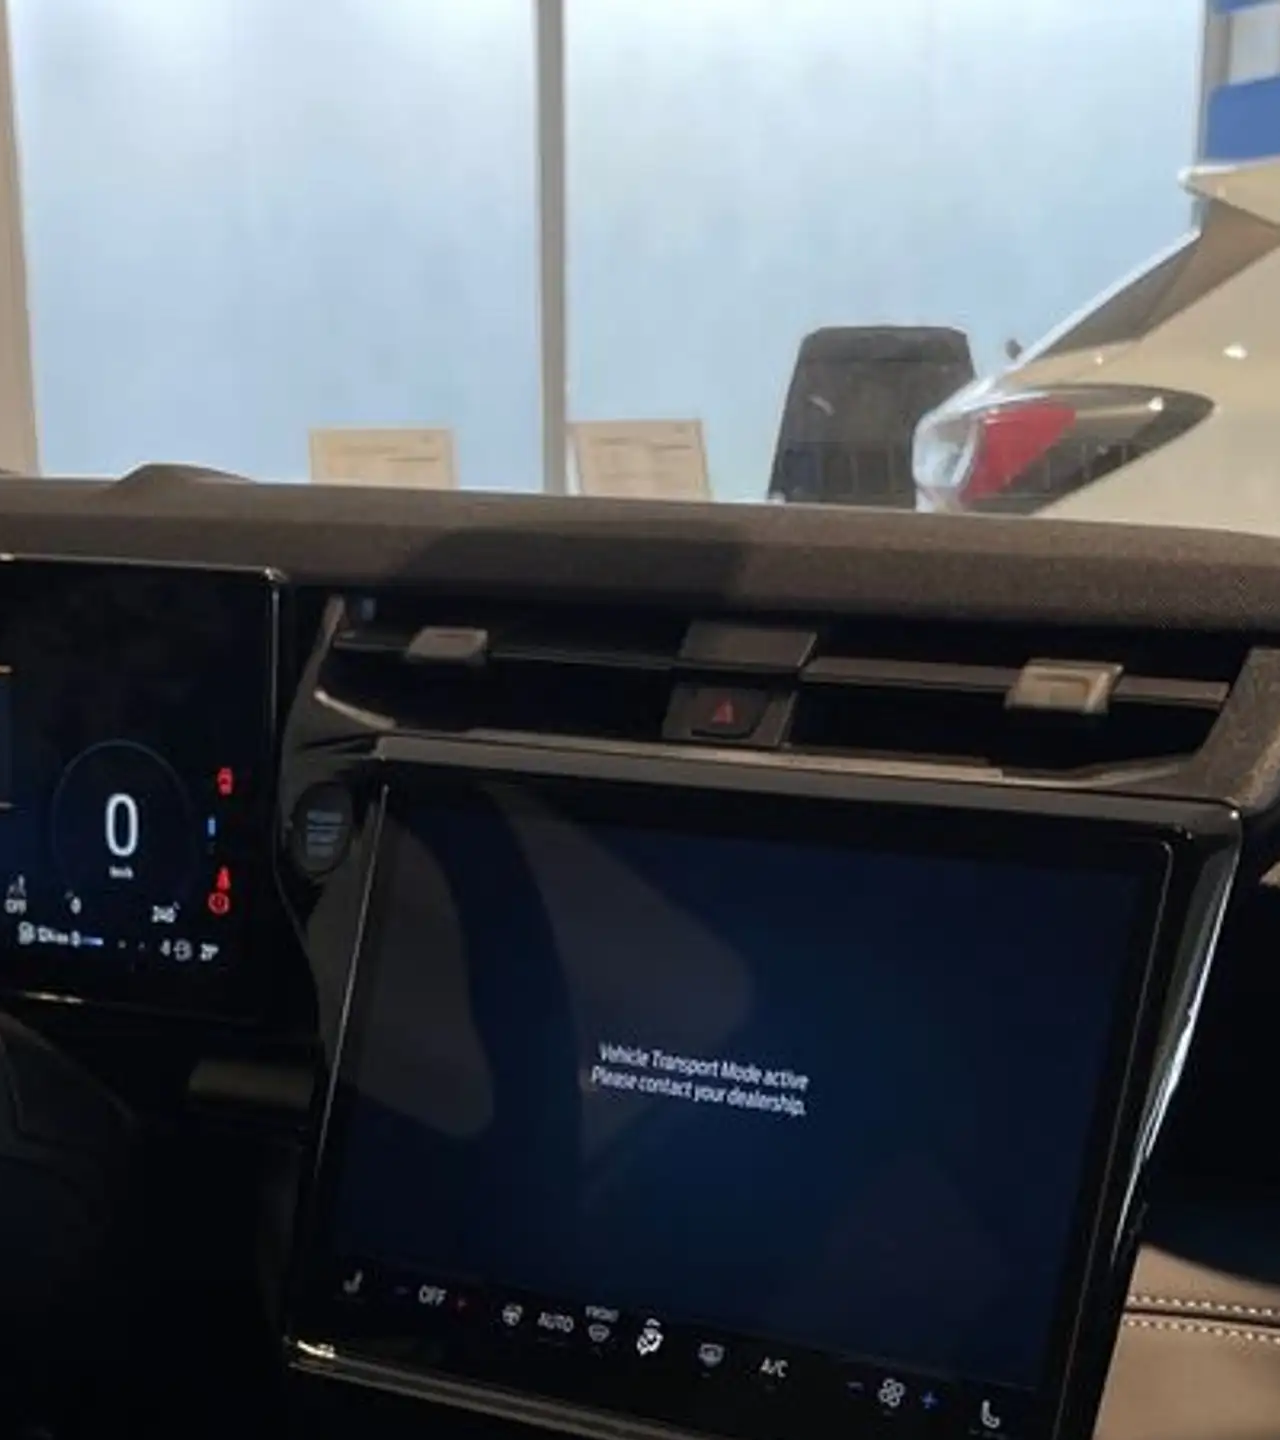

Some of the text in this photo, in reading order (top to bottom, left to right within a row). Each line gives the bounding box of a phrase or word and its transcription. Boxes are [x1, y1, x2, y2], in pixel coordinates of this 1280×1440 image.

[103, 791, 140, 859] 0
[599, 1041, 810, 1092] Vehicle Transport Mode active
[590, 1065, 807, 1117] Please contact your dealership.
[418, 1283, 448, 1308] OFF
[538, 1310, 575, 1337] AUTO
[760, 1355, 788, 1381] A/C
